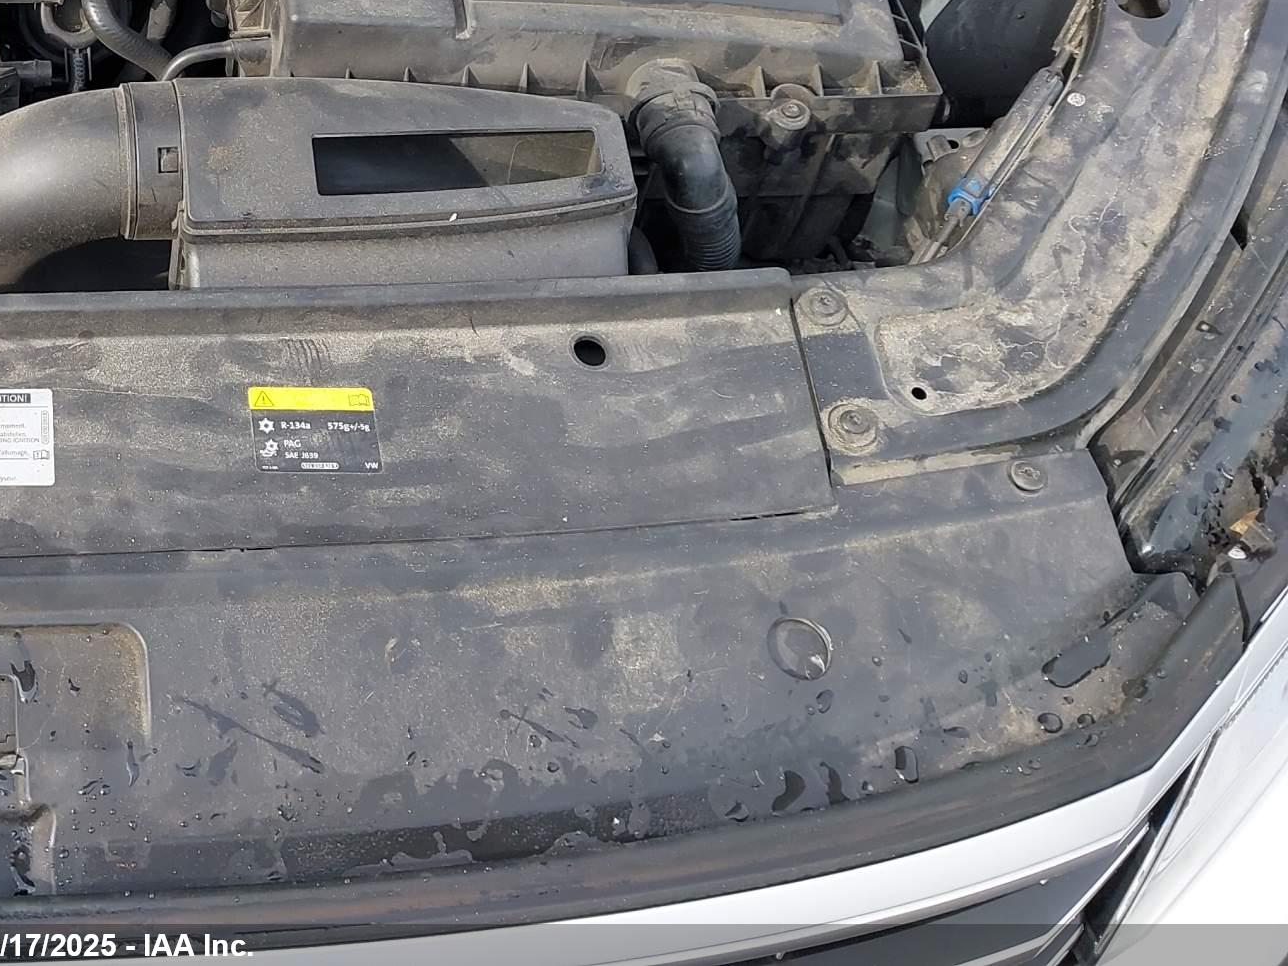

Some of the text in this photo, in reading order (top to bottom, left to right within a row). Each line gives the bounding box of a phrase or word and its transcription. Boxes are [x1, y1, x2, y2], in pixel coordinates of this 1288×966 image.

[281, 421, 370, 432] R-134a 575g+/-5g
[284, 440, 301, 448] PAG
